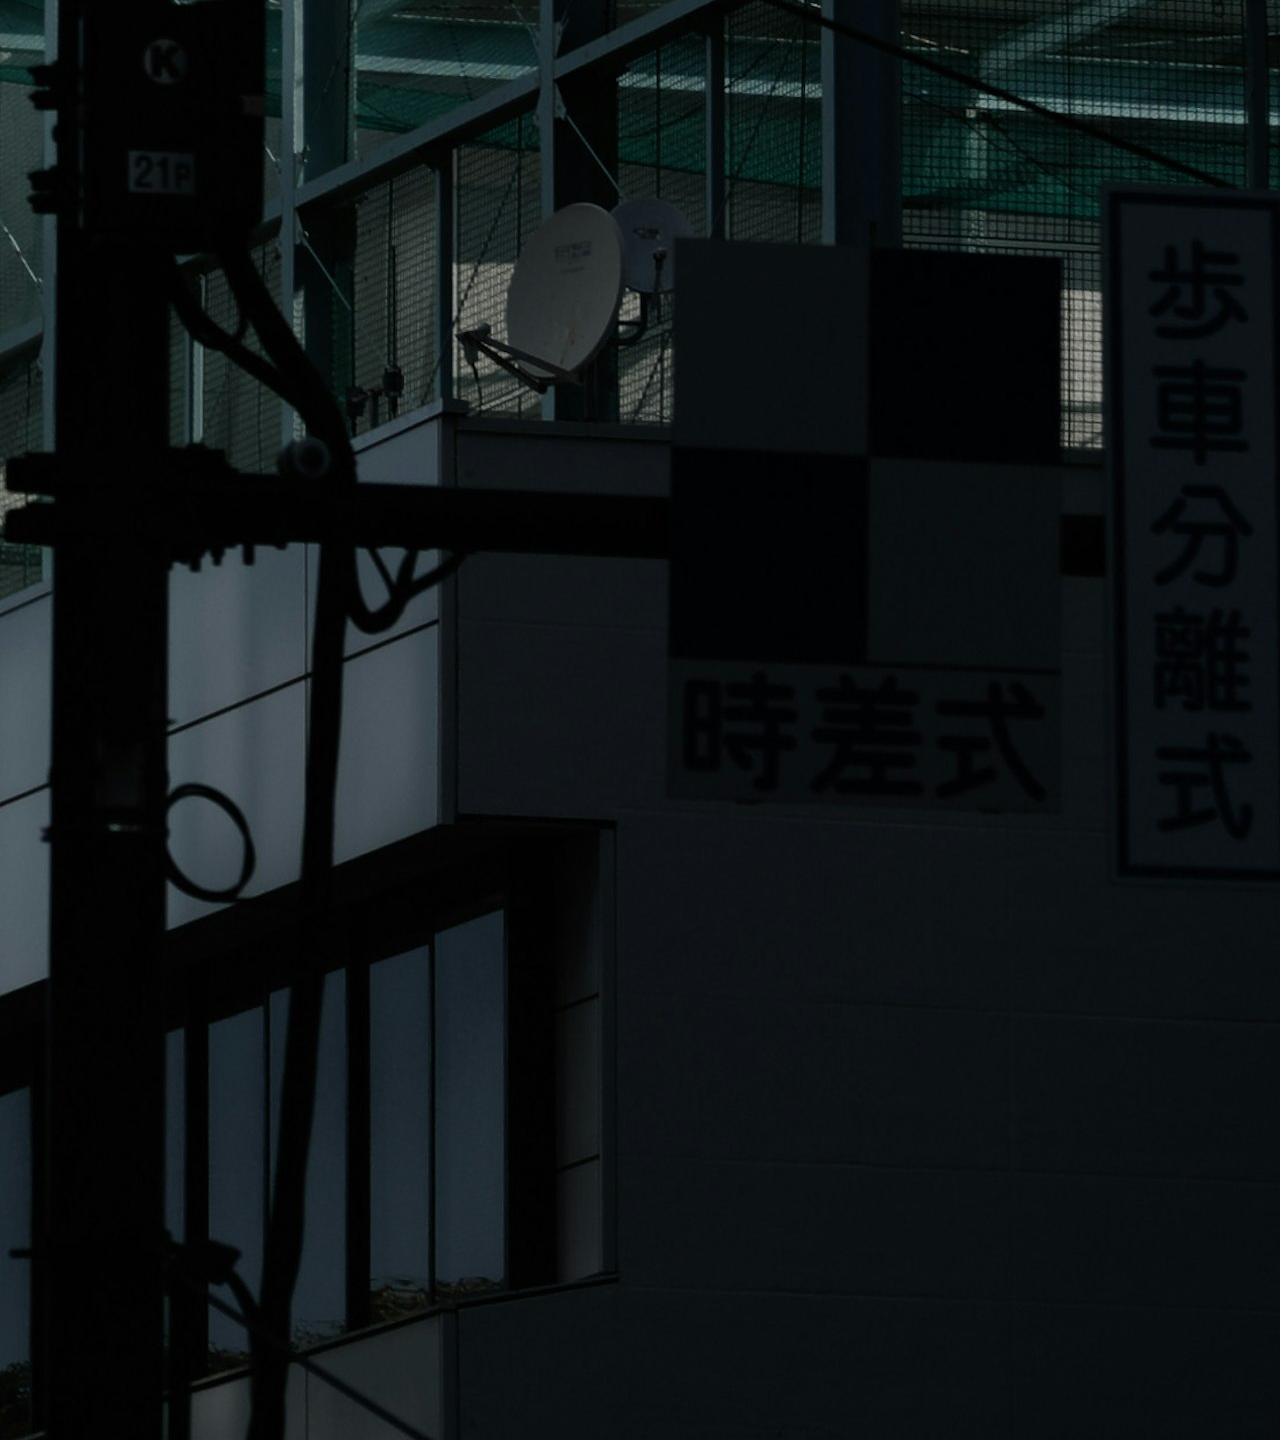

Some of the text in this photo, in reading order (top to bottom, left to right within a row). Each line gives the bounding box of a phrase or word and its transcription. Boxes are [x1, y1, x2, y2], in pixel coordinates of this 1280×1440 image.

[152, 45, 180, 78] K
[1148, 240, 1253, 840] 歩車分離式
[683, 672, 1046, 801] 時差式
